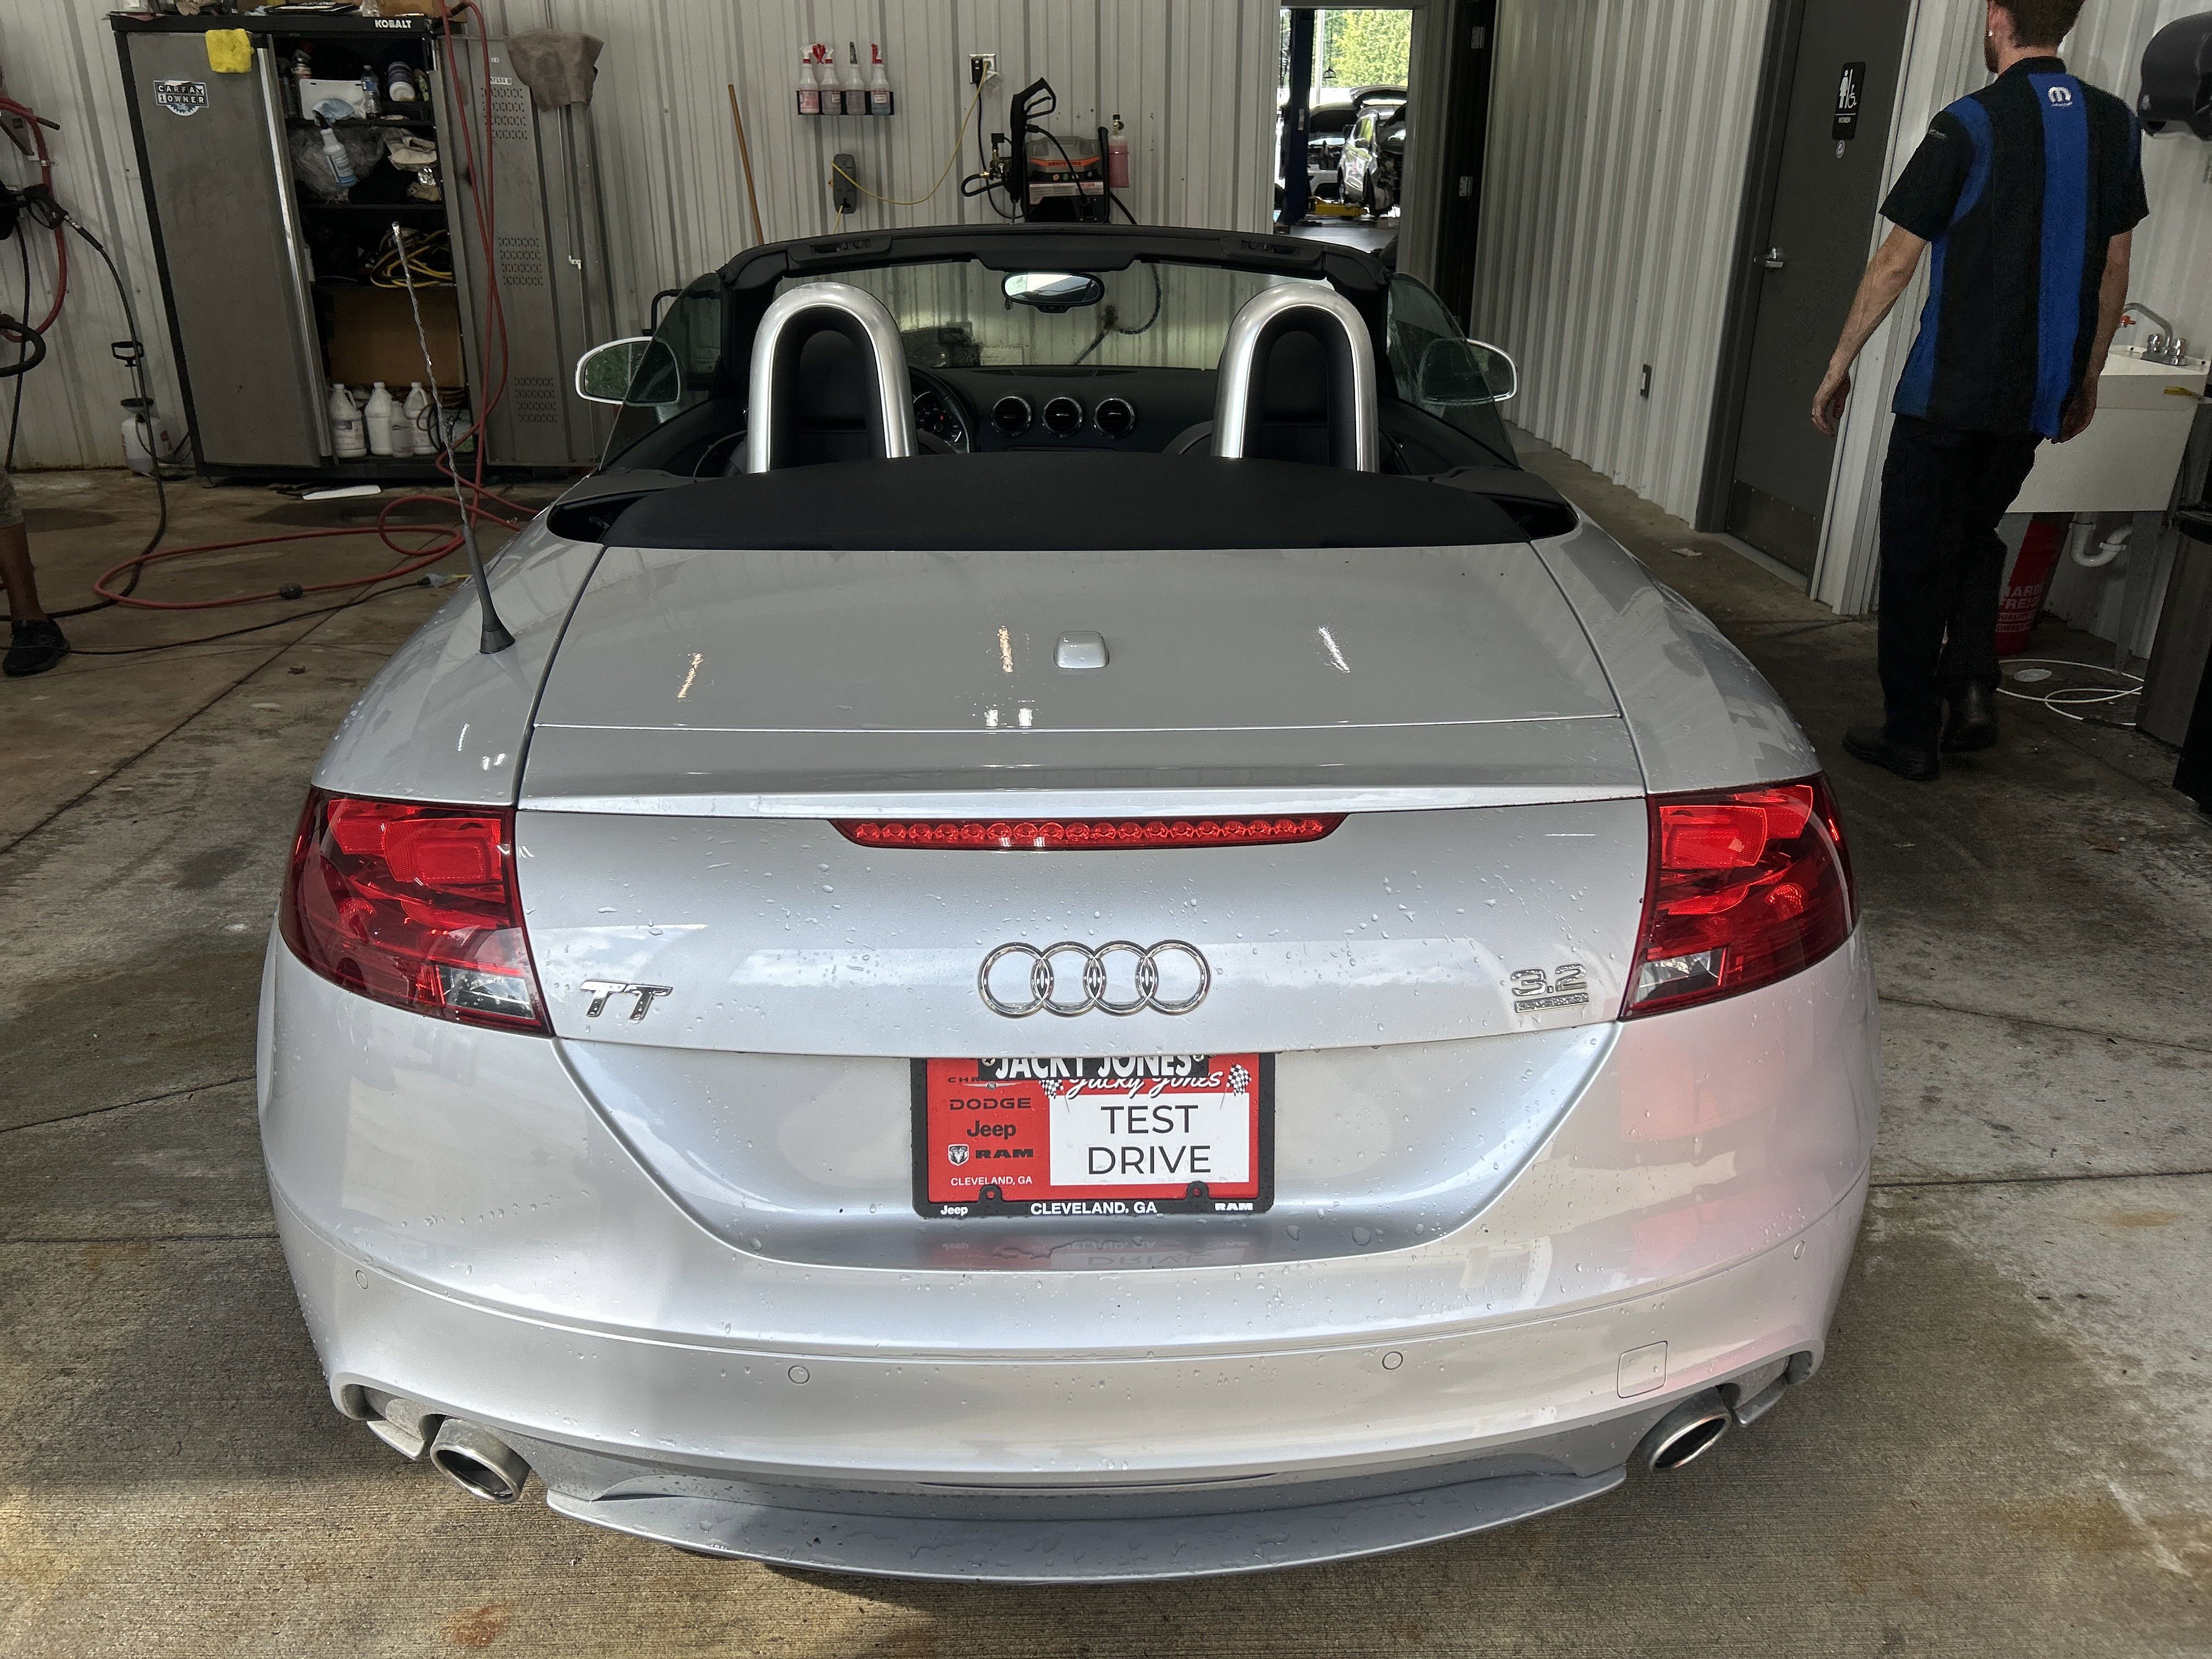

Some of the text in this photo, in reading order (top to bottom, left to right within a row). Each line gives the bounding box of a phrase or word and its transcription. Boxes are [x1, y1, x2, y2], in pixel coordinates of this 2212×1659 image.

[375, 20, 411, 28] KOBALT
[158, 85, 205, 94] CARFAX
[1510, 964, 1587, 996] 3.2
[579, 979, 673, 1020] TT
[995, 1056, 1192, 1079] JACKY JONES
[950, 1098, 1031, 1110] DODGE
[1101, 1105, 1199, 1134] TEST
[967, 1120, 1016, 1139] Jeep
[975, 1148, 1034, 1159] RAM
[1088, 1146, 1211, 1175] DRIVE
[951, 1176, 1032, 1186] CLEVELAND, GA
[940, 1205, 968, 1216] Jeep
[1030, 1201, 1158, 1215] CLEVELAND, GA
[1215, 1203, 1254, 1211] RAM
